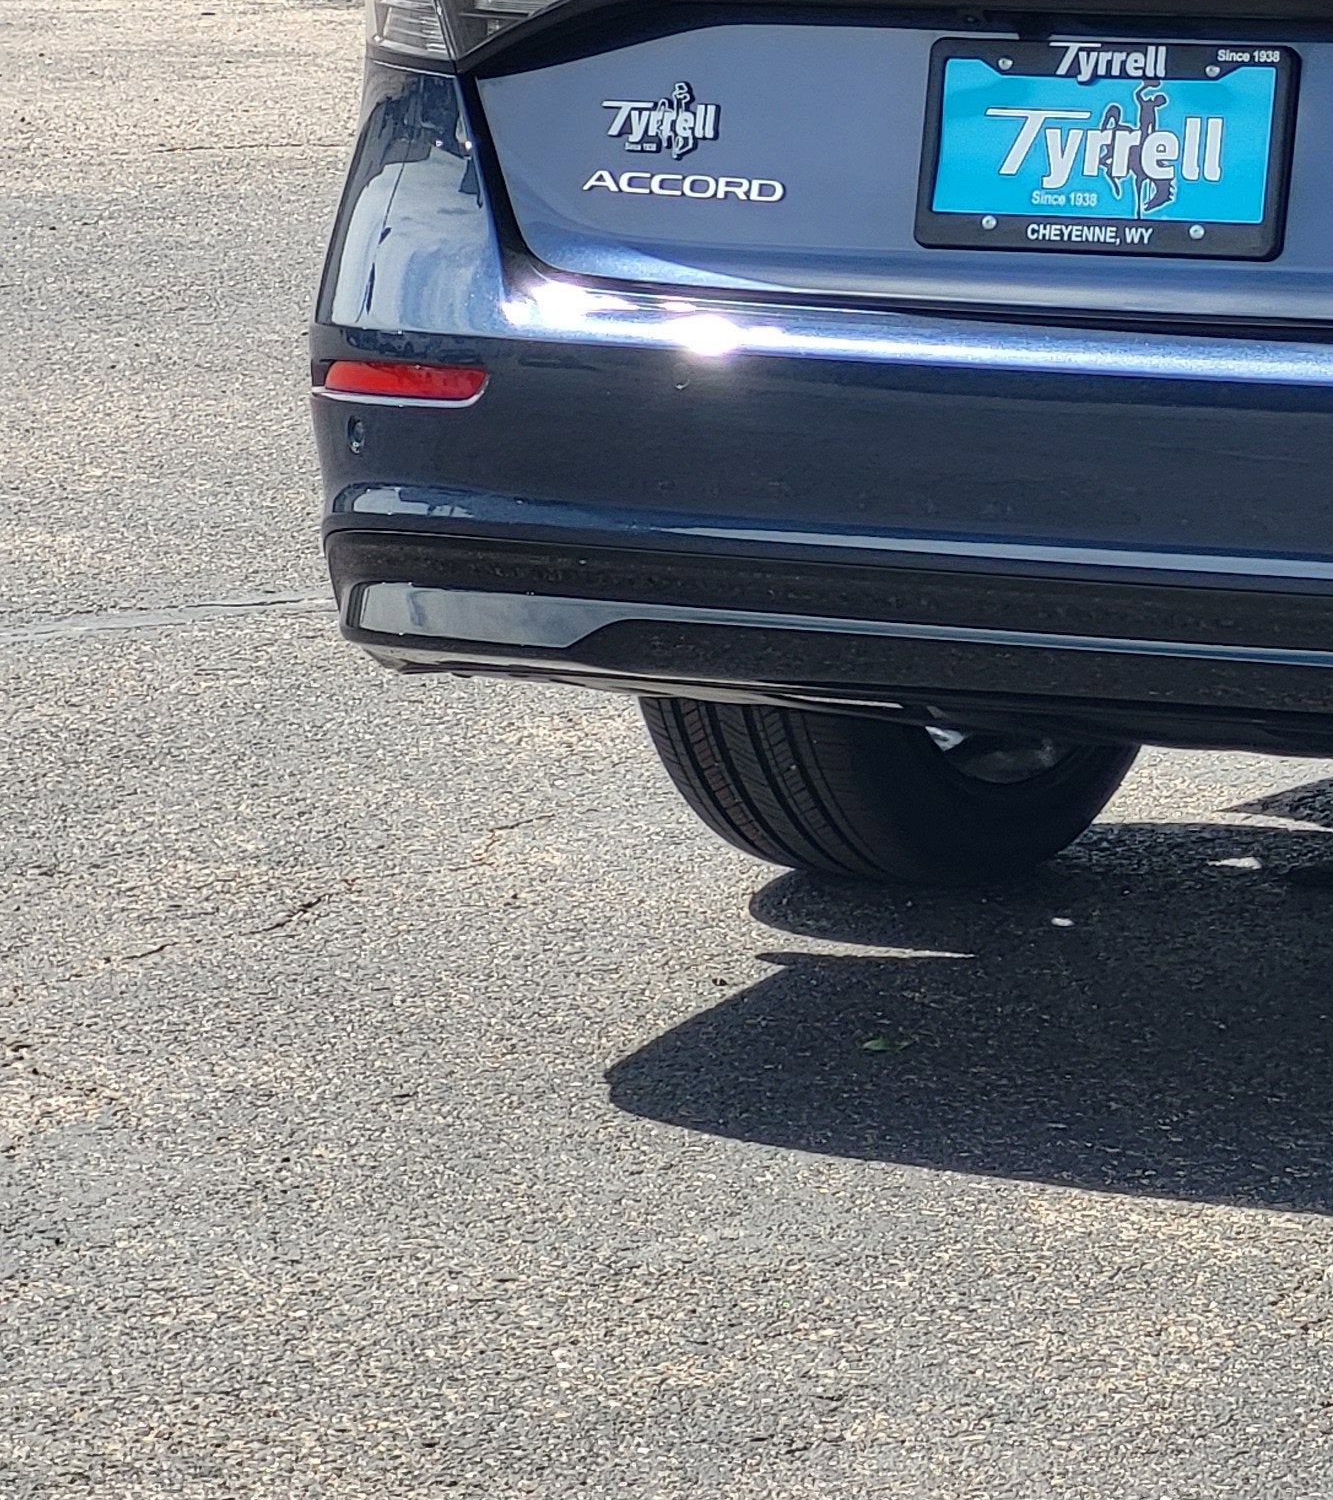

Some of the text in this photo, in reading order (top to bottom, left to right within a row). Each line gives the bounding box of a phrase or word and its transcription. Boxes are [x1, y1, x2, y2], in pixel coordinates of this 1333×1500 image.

[1049, 41, 1167, 82] Tyrrell
[1217, 49, 1281, 63] Since 1938
[602, 100, 717, 142] Tyrrell
[985, 107, 1225, 189] Tyrrell
[581, 170, 786, 202] ACCORD
[1031, 191, 1098, 207] Since 1938
[1026, 224, 1153, 246] CHEYENNE, WY
